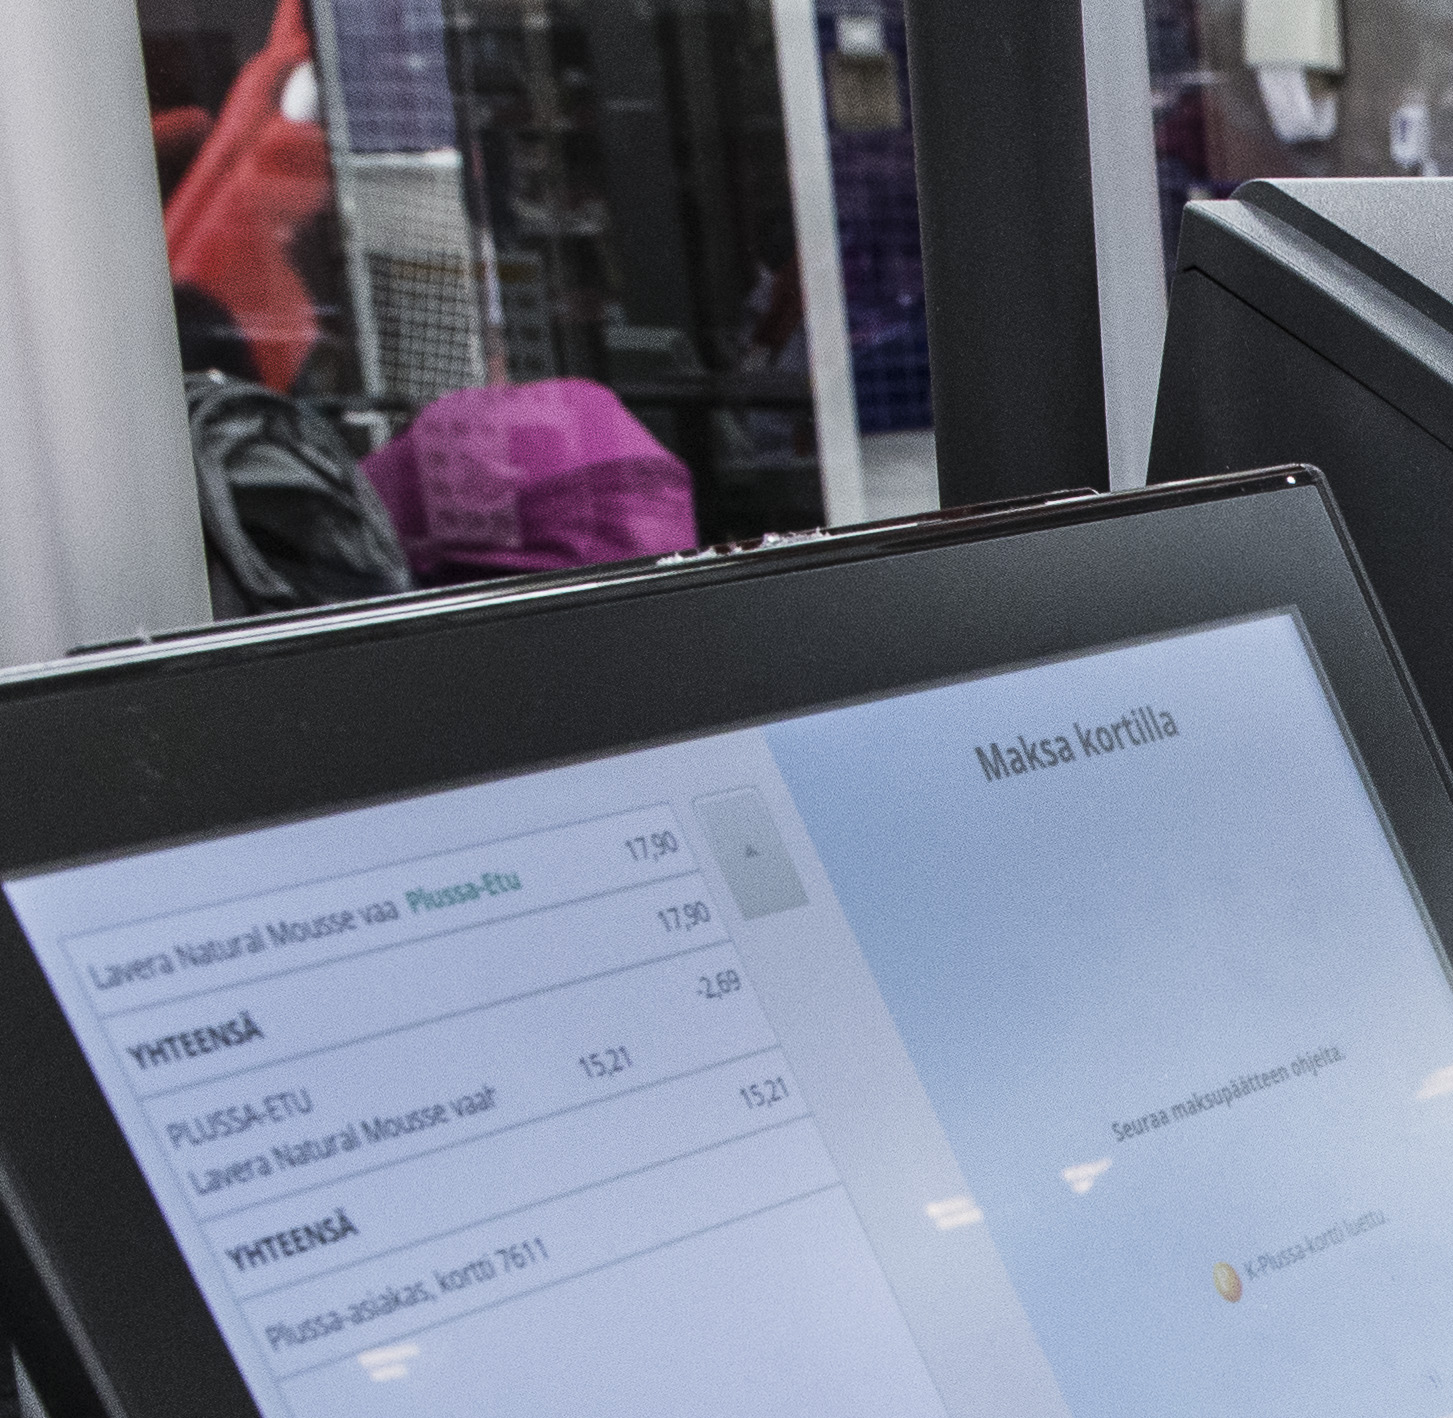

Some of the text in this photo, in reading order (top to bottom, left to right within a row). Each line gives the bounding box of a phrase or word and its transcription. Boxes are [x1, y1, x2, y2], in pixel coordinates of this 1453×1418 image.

[974, 705, 1181, 783] Maksa kortilla
[624, 830, 680, 863] 17,90
[88, 949, 175, 991] Lavera
[173, 926, 266, 970] Natural
[266, 907, 358, 949] Mousse
[404, 870, 523, 914] Plussa-Etu
[657, 900, 711, 933] 17,90
[126, 1010, 265, 1070] YHTEENSÄ
[578, 1046, 632, 1079] 15,21
[166, 1088, 315, 1150] PLUSSA-ETU
[739, 1076, 789, 1109] 15,21
[1111, 1106, 1168, 1143] Seuraa
[1171, 1067, 1289, 1121] maksupäätteen
[187, 1155, 274, 1195] Lavera
[271, 1123, 362, 1170] Natural
[360, 1102, 449, 1146] Mousse
[225, 1207, 359, 1272] YHTEENSÄ
[264, 1236, 552, 1351] Plussa-asiakas, kortti 7611
